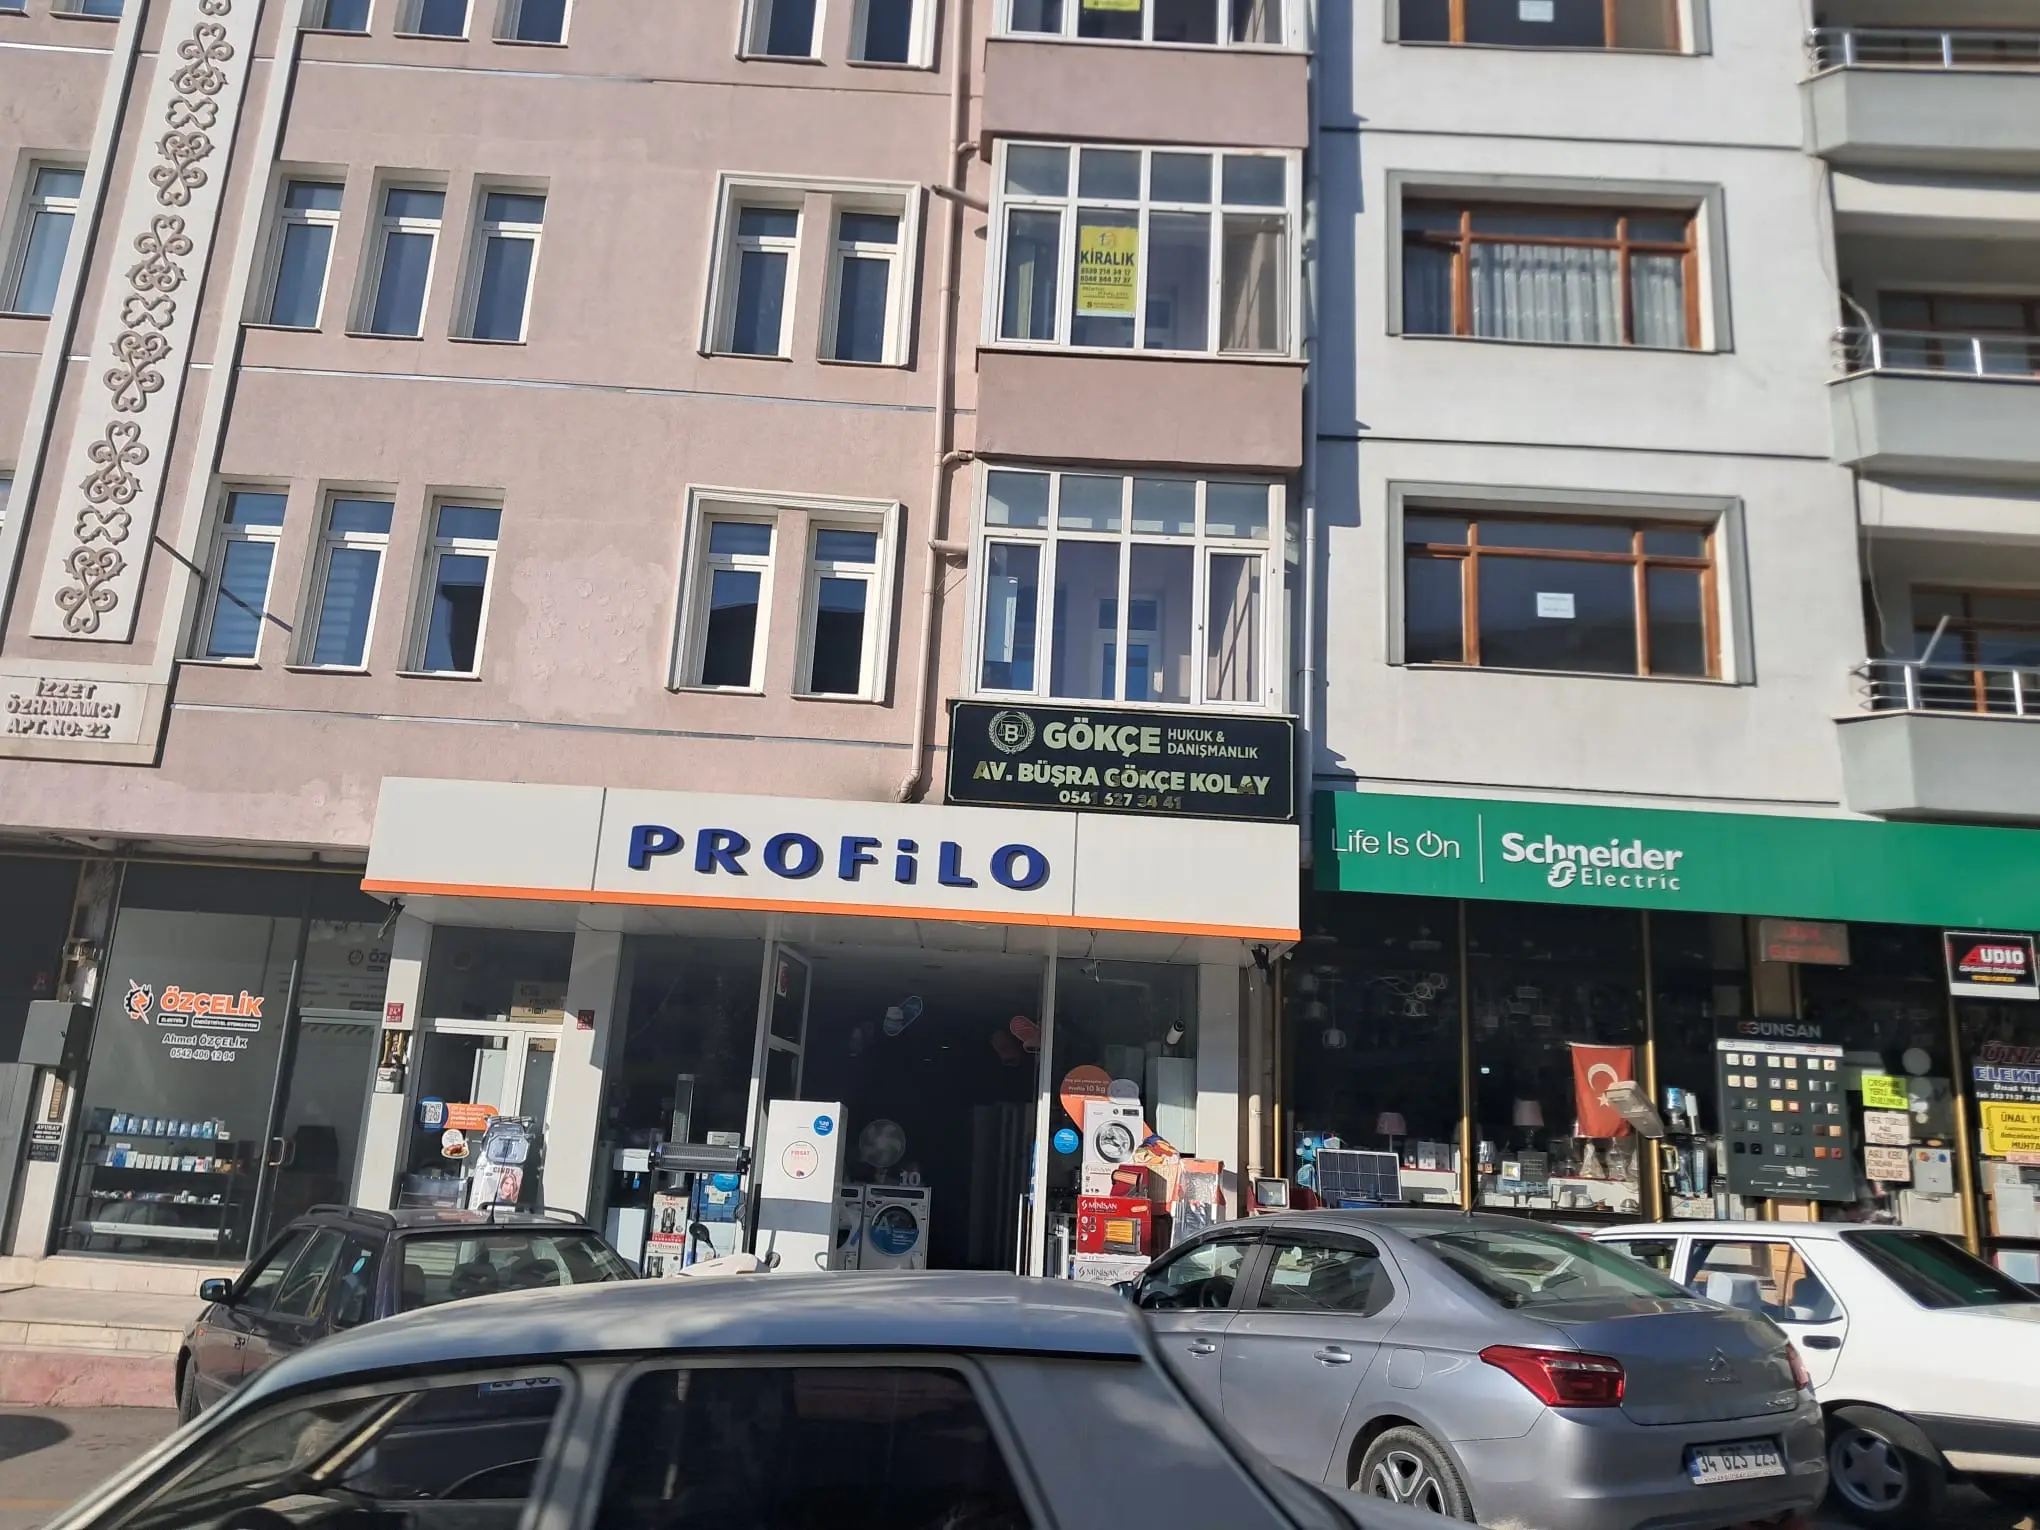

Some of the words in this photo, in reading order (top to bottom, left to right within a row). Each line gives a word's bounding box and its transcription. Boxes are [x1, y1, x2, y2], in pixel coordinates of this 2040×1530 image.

[1080, 248, 1135, 266] KİRALIK
[36, 677, 97, 699] İZZET
[1043, 717, 1161, 758] GÖKÇE
[1167, 728, 1212, 743] HUKUK
[1216, 730, 1225, 742] &
[1167, 743, 1258, 760] DANIŞMANLIK
[972, 760, 1012, 782] AV.
[1018, 760, 1099, 788] BÜŞRA
[1103, 765, 1185, 795] GÖKÇE
[1190, 772, 1270, 796] KOLAY
[1332, 828, 1380, 854] Life
[1387, 831, 1409, 856] Is
[1416, 830, 1460, 859] On
[1501, 832, 1683, 871] Schneider
[1581, 870, 1681, 891] Electric
[160, 986, 264, 1017] ÖZÇELİK
[162, 1033, 197, 1045] Ahmet
[199, 1033, 248, 1049] ÖZÇELİK
[1748, 1022, 1822, 1039] GÜNSAN
